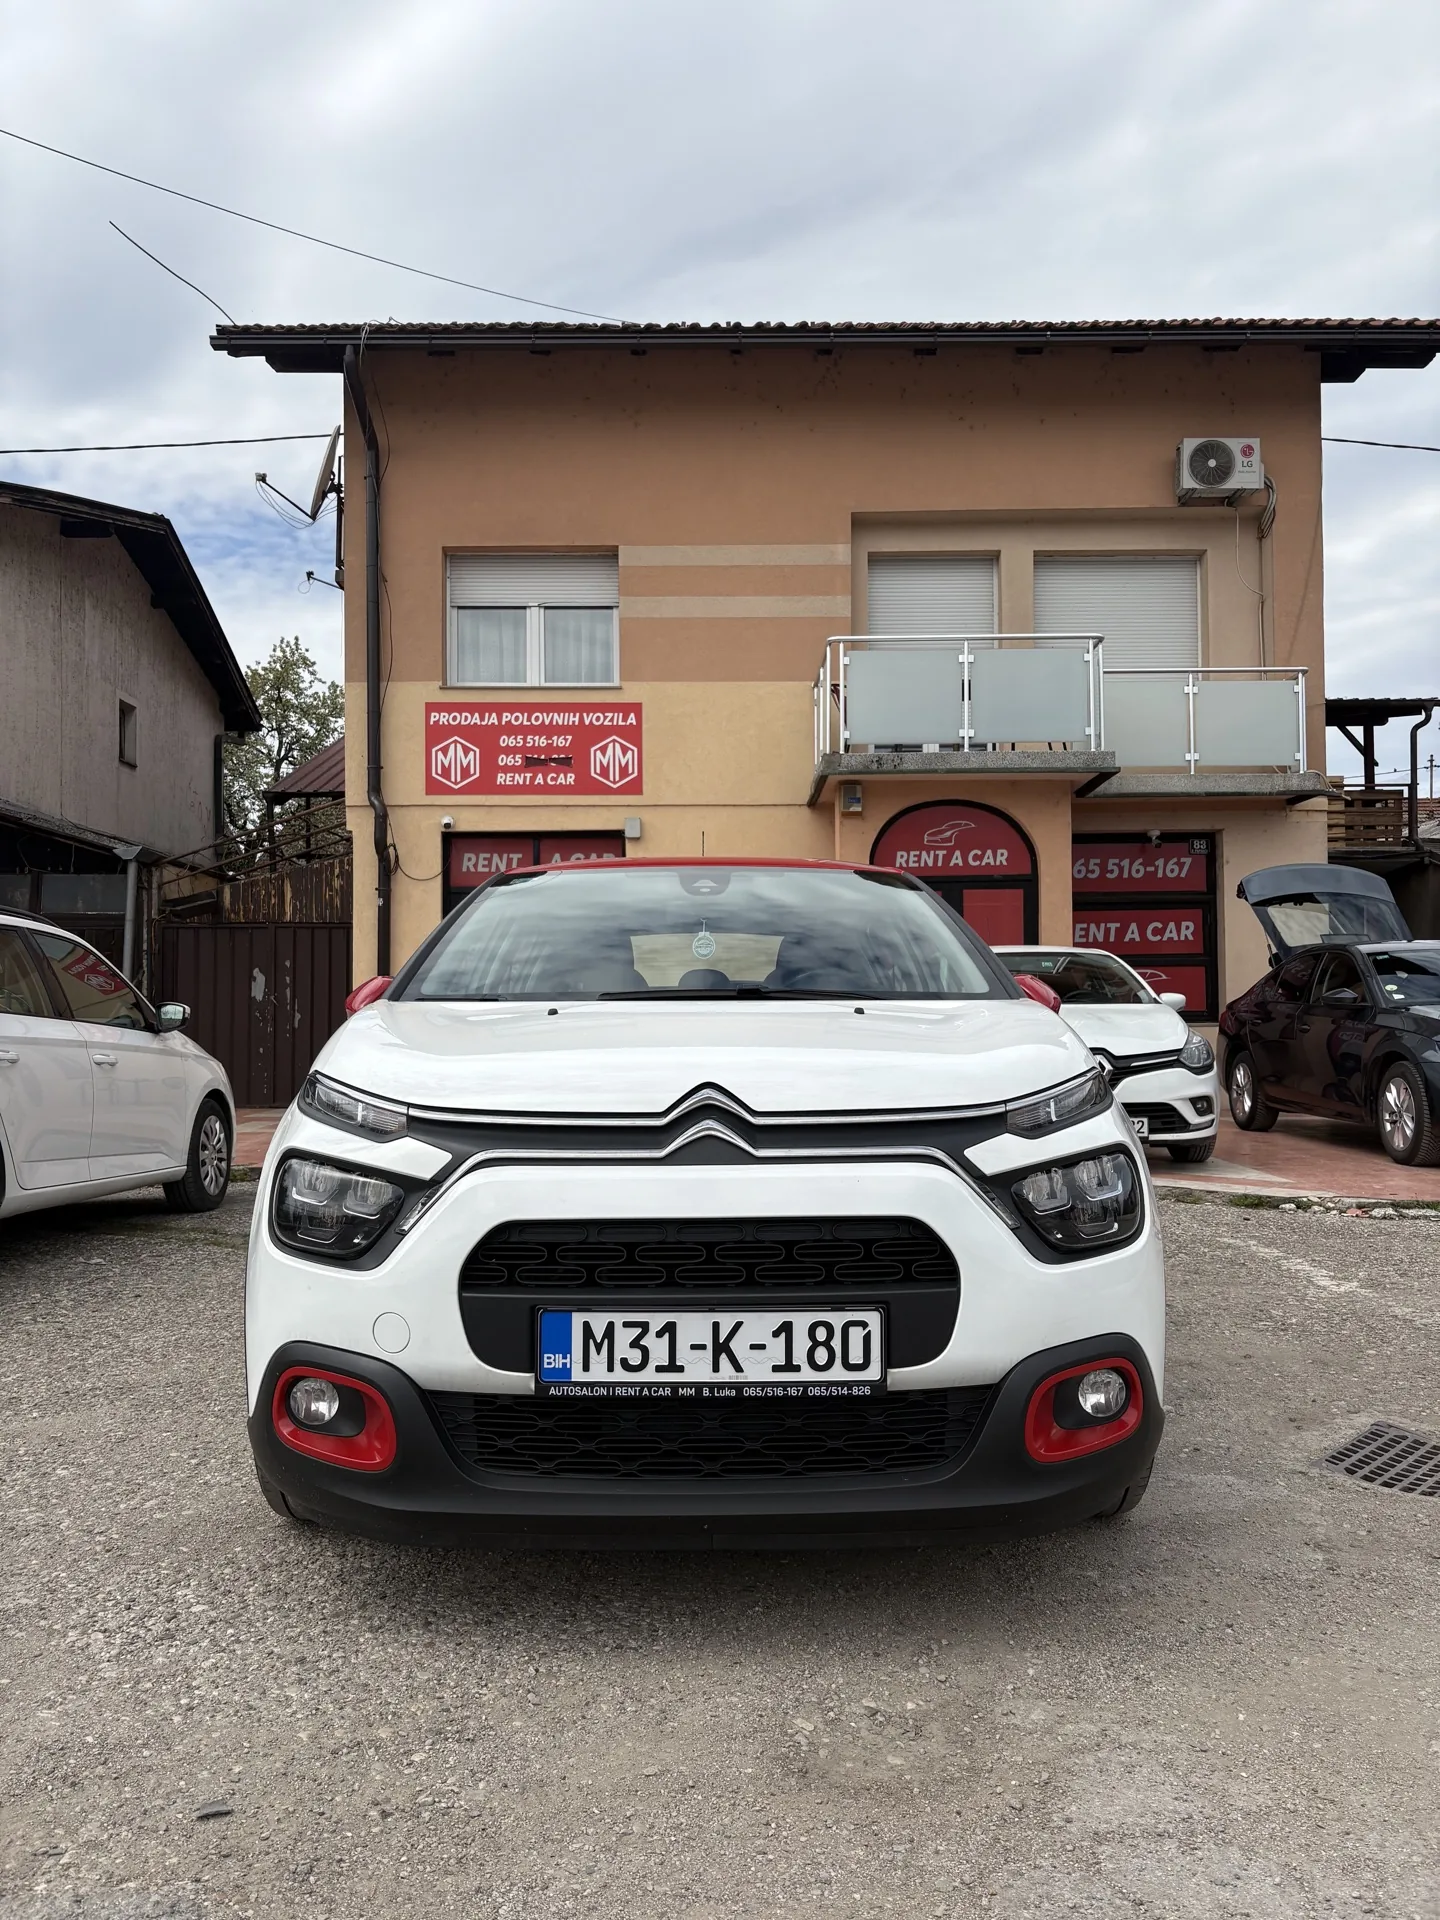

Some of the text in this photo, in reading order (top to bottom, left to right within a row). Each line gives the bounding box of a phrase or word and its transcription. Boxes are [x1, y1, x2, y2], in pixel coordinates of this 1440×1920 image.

[1241, 460, 1253, 468] LG
[429, 712, 637, 726] PRODAJA POLOVNIH VOZILA
[499, 735, 573, 747] 065 516-167
[498, 754, 522, 766] 065
[496, 773, 576, 785] RENT A CAR
[1193, 839, 1207, 849] 83
[461, 853, 523, 873] RENT
[895, 848, 1009, 868] RENT A CAR
[1105, 856, 1192, 879] 516-167
[1124, 922, 1141, 942] A
[1146, 921, 1195, 942] CAR
[1131, 1119, 1145, 1134] 2
[543, 1319, 873, 1374] BIH M31-K-180
[548, 1386, 607, 1396] AUTOSALON
[615, 1387, 641, 1396] RENT
[642, 1387, 650, 1396] A
[650, 1387, 672, 1396] CAR
[678, 1387, 695, 1396] MM
[702, 1387, 712, 1396] B.
[714, 1387, 736, 1396] Luka
[743, 1386, 803, 1397] 065/516-167
[807, 1386, 871, 1396] 065/514-826
